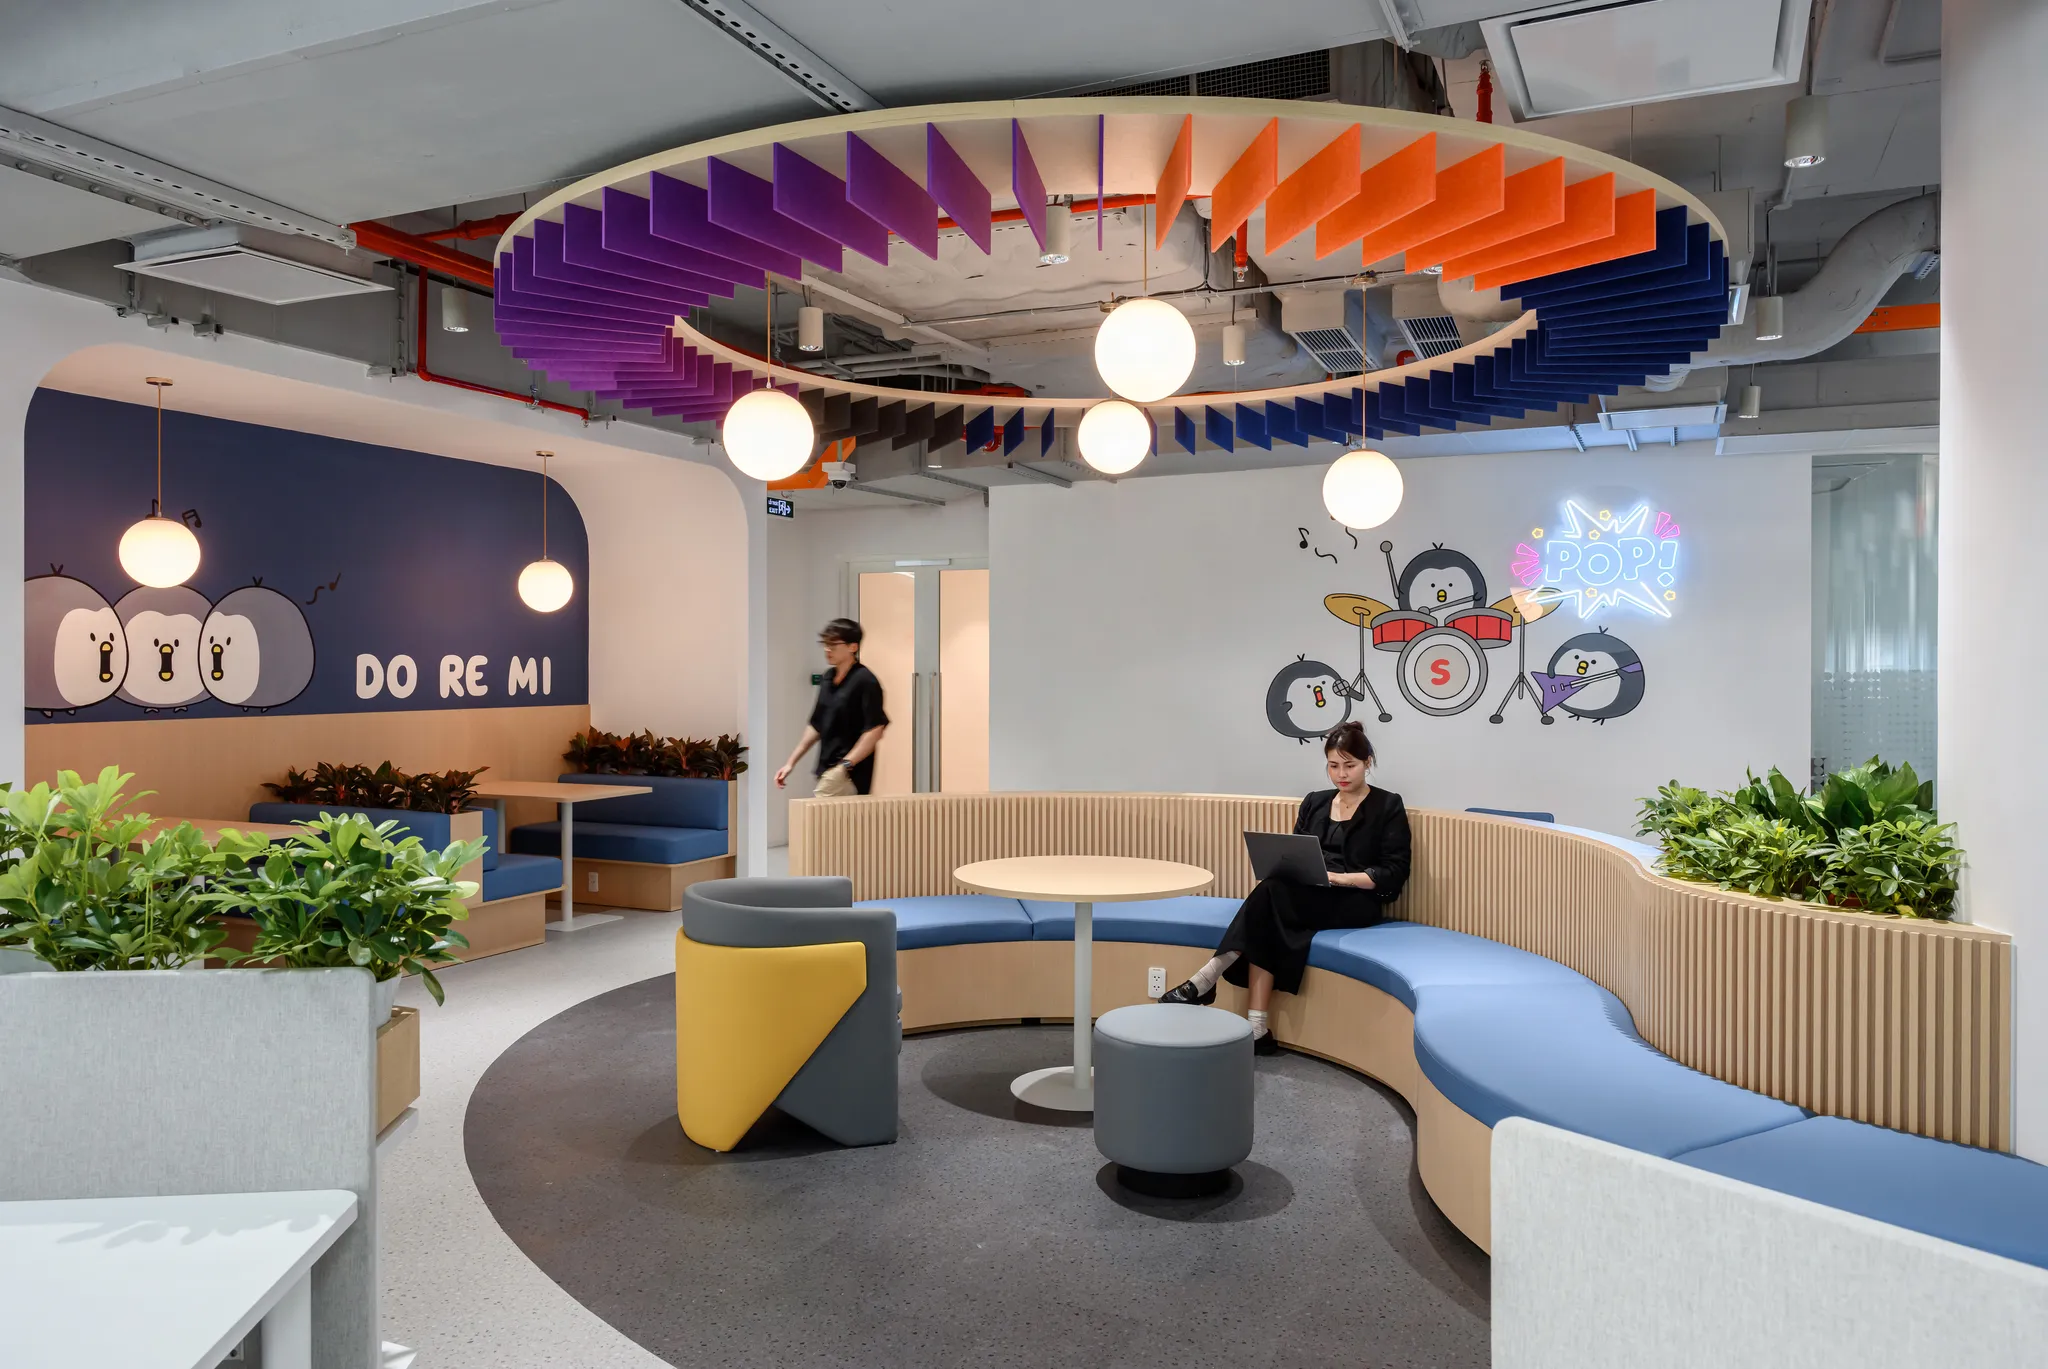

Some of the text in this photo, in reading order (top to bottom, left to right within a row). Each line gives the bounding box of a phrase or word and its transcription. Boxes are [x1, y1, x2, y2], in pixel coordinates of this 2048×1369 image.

[1545, 537, 1678, 587] POP!
[356, 653, 551, 699] DO RE MI
[1430, 659, 1450, 685] S
